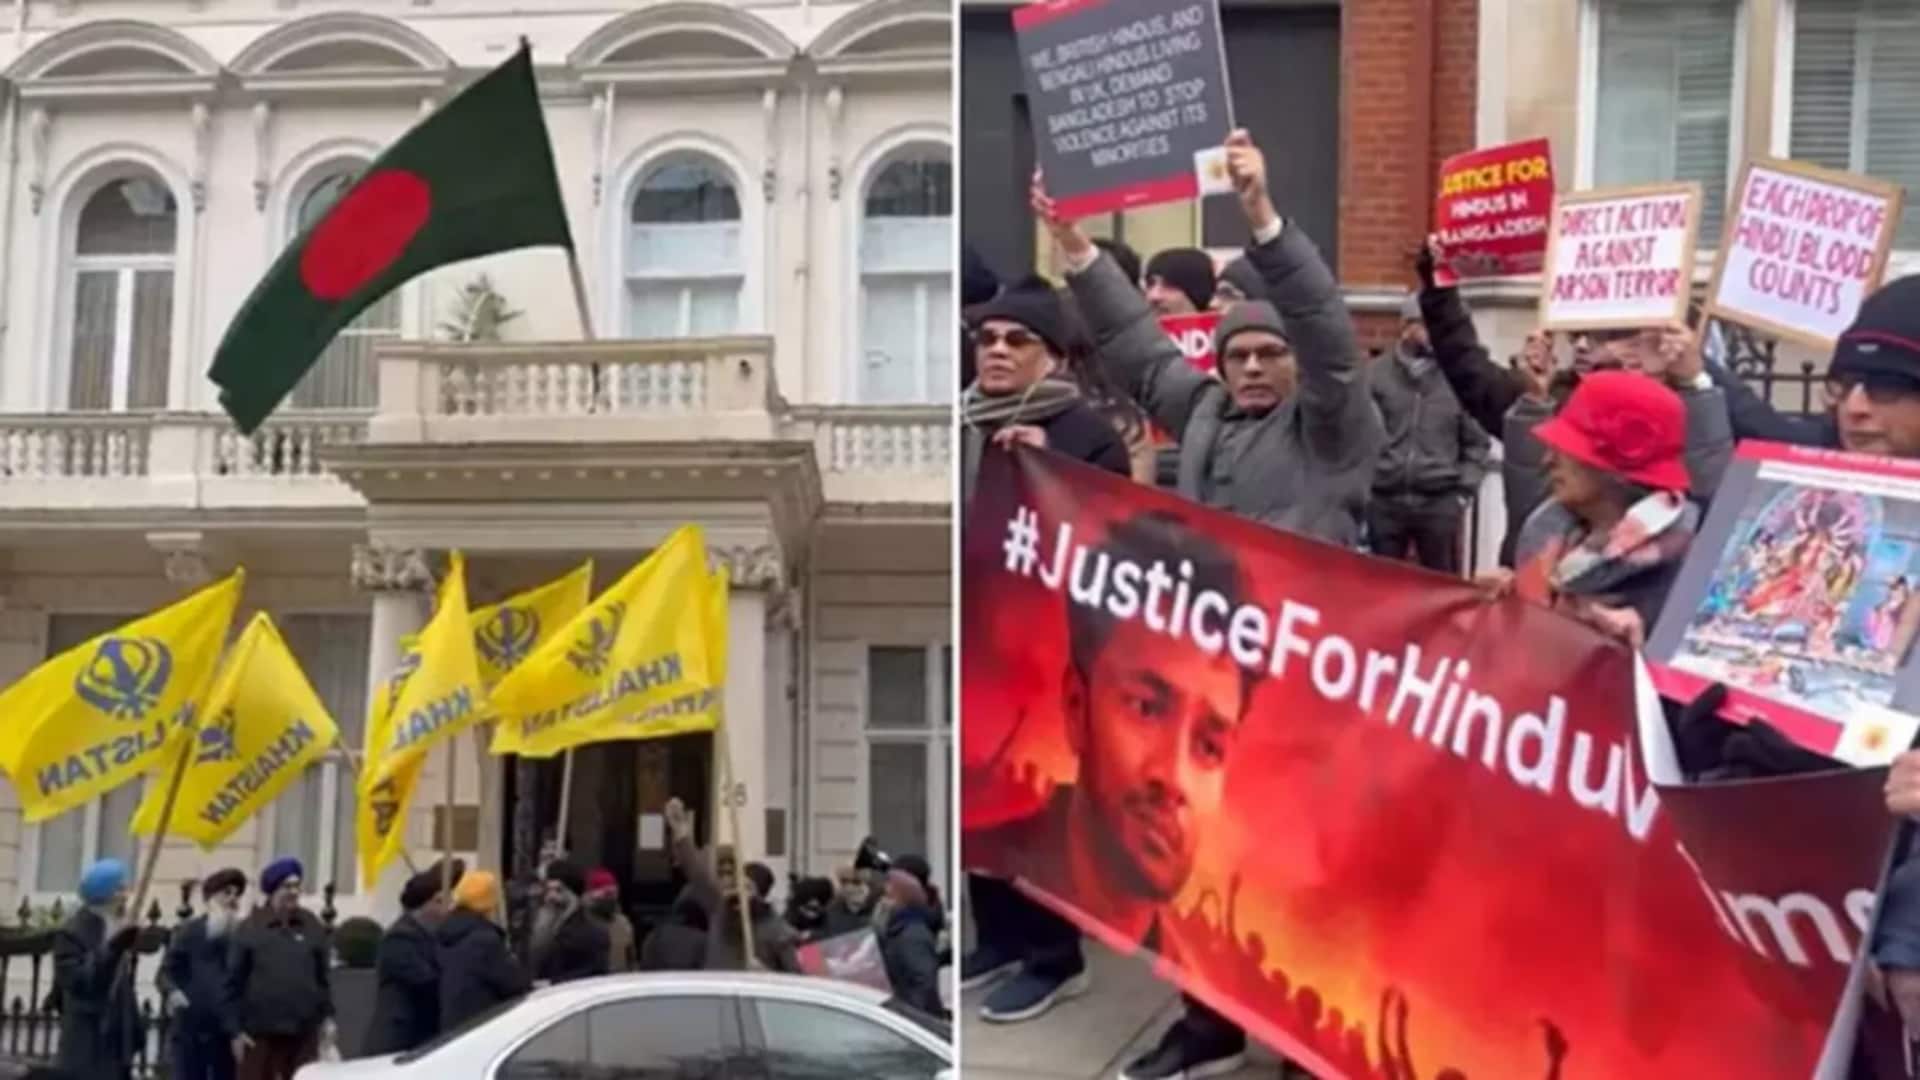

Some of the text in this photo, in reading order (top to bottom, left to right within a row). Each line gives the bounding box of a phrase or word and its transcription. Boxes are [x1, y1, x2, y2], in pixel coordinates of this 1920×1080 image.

[1170, 4, 1203, 30] AND
[1038, 61, 1096, 92] BENGALI
[1152, 30, 1201, 60] LIVING
[1109, 62, 1173, 95] DEMAND
[1048, 76, 1206, 134] BANGLADESH TO STOP
[1053, 101, 1208, 154] VIOLENCE AGAINST ITS
[1090, 134, 1170, 168] MINORITIES
[1506, 155, 1548, 185] FOR
[1450, 190, 1528, 218] HINDUS IN
[1560, 200, 1687, 237] DIRECT ACTION
[1746, 175, 1885, 241] EACH DROP OF
[1575, 236, 1658, 269] AGAINST
[1735, 215, 1875, 281] HINDU BLOOD
[1550, 267, 1681, 301] ARSON TERROR
[1748, 257, 1843, 316] COUNTS
